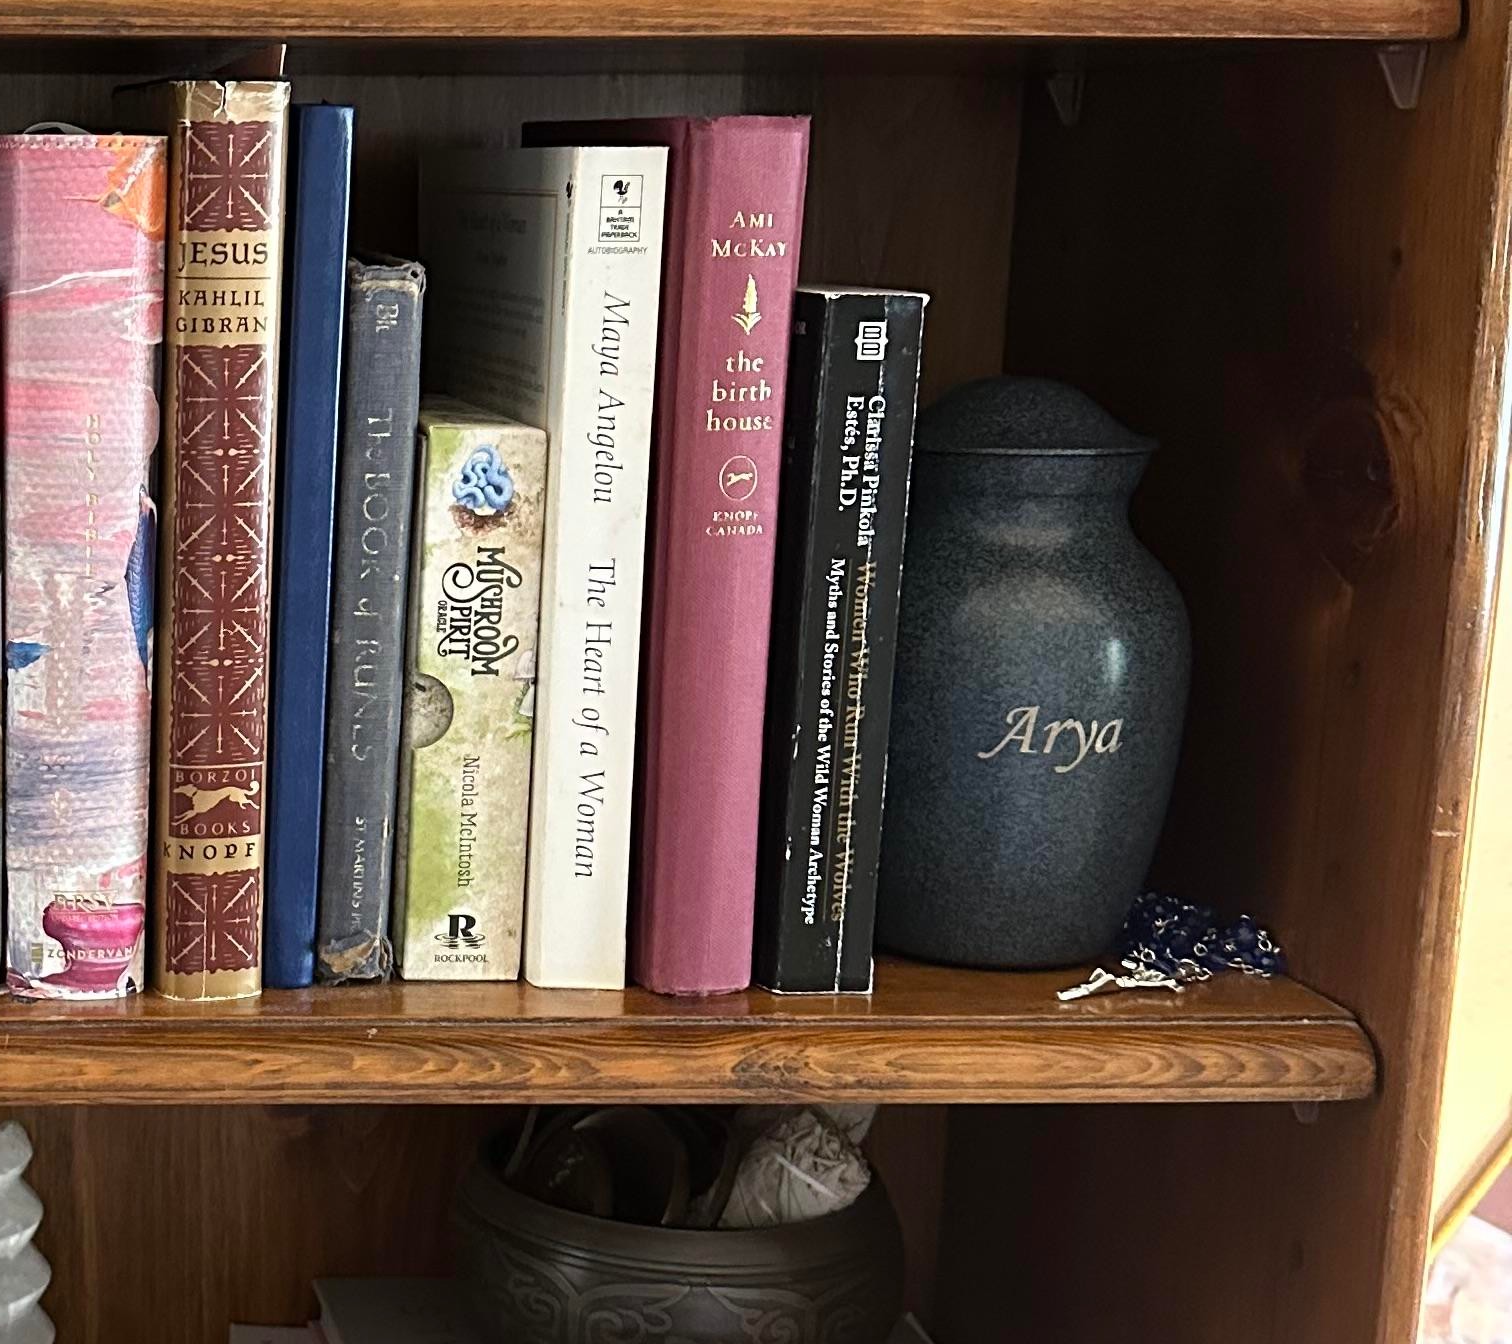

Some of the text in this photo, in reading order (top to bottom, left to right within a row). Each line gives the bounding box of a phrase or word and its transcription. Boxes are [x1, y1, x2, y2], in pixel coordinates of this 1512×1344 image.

[178, 240, 269, 271] JESUS
[178, 289, 265, 306] KAHLIL
[176, 316, 267, 333] GIBRAN
[726, 350, 764, 372] the
[587, 290, 630, 503] Maya Angelou
[712, 380, 772, 402] birth
[707, 409, 773, 431] house
[977, 705, 1124, 774] Arya
[456, 756, 480, 887] Nicola McIntosh
[434, 954, 489, 963] ROCKPOOL
